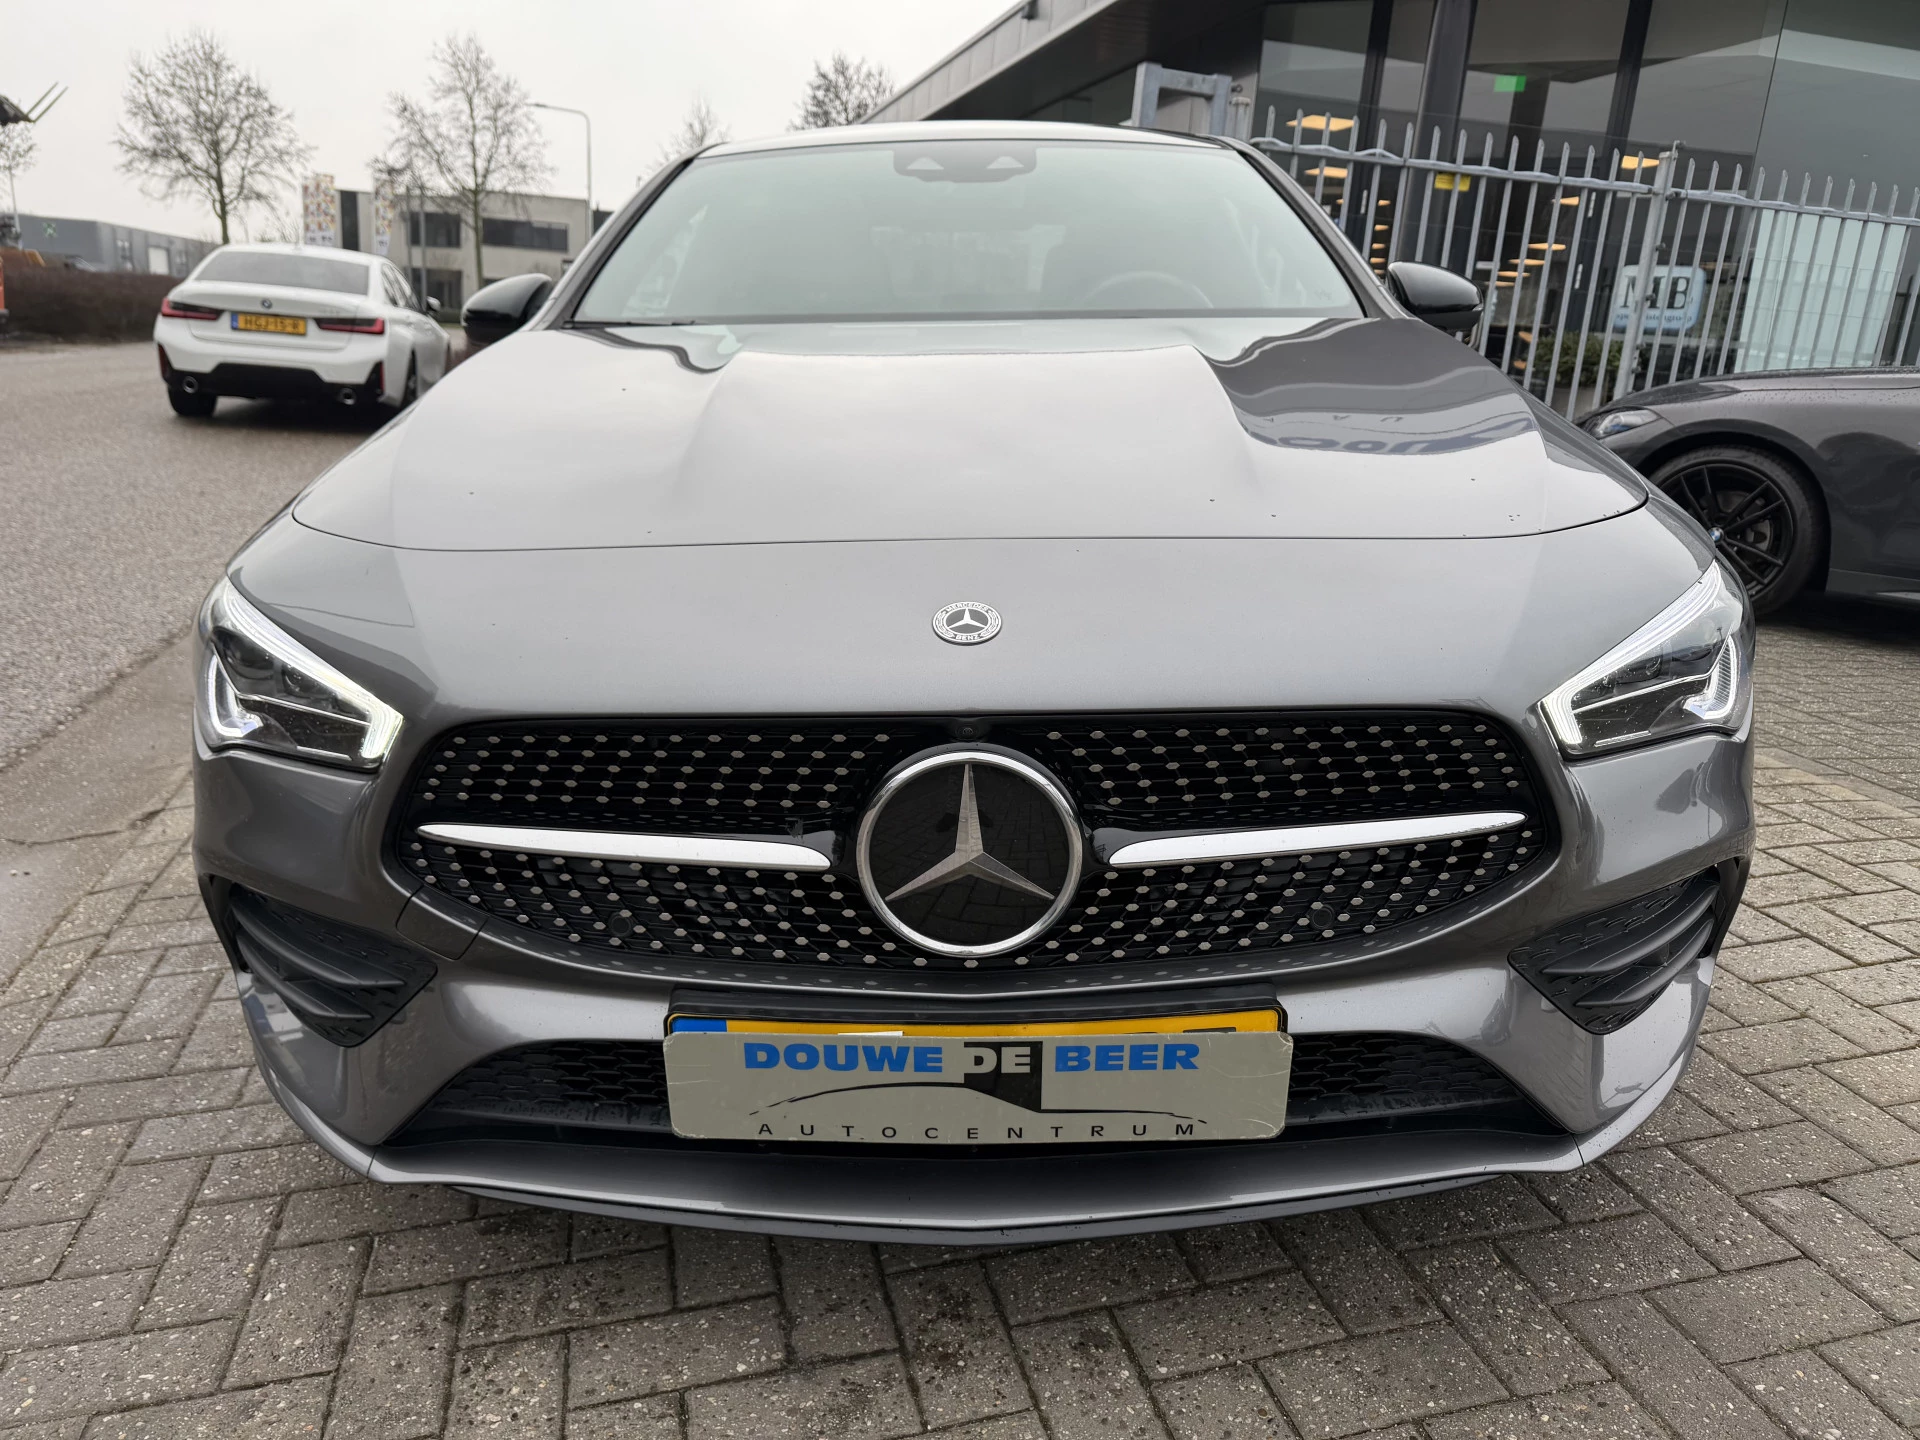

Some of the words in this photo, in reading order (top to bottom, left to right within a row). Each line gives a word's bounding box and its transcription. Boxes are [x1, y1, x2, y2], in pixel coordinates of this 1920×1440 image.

[743, 1042, 943, 1073] DOUWE
[970, 1046, 1031, 1074] DE
[1054, 1043, 1200, 1073] BEER
[758, 1123, 1194, 1139] AUTOCENTRUM
